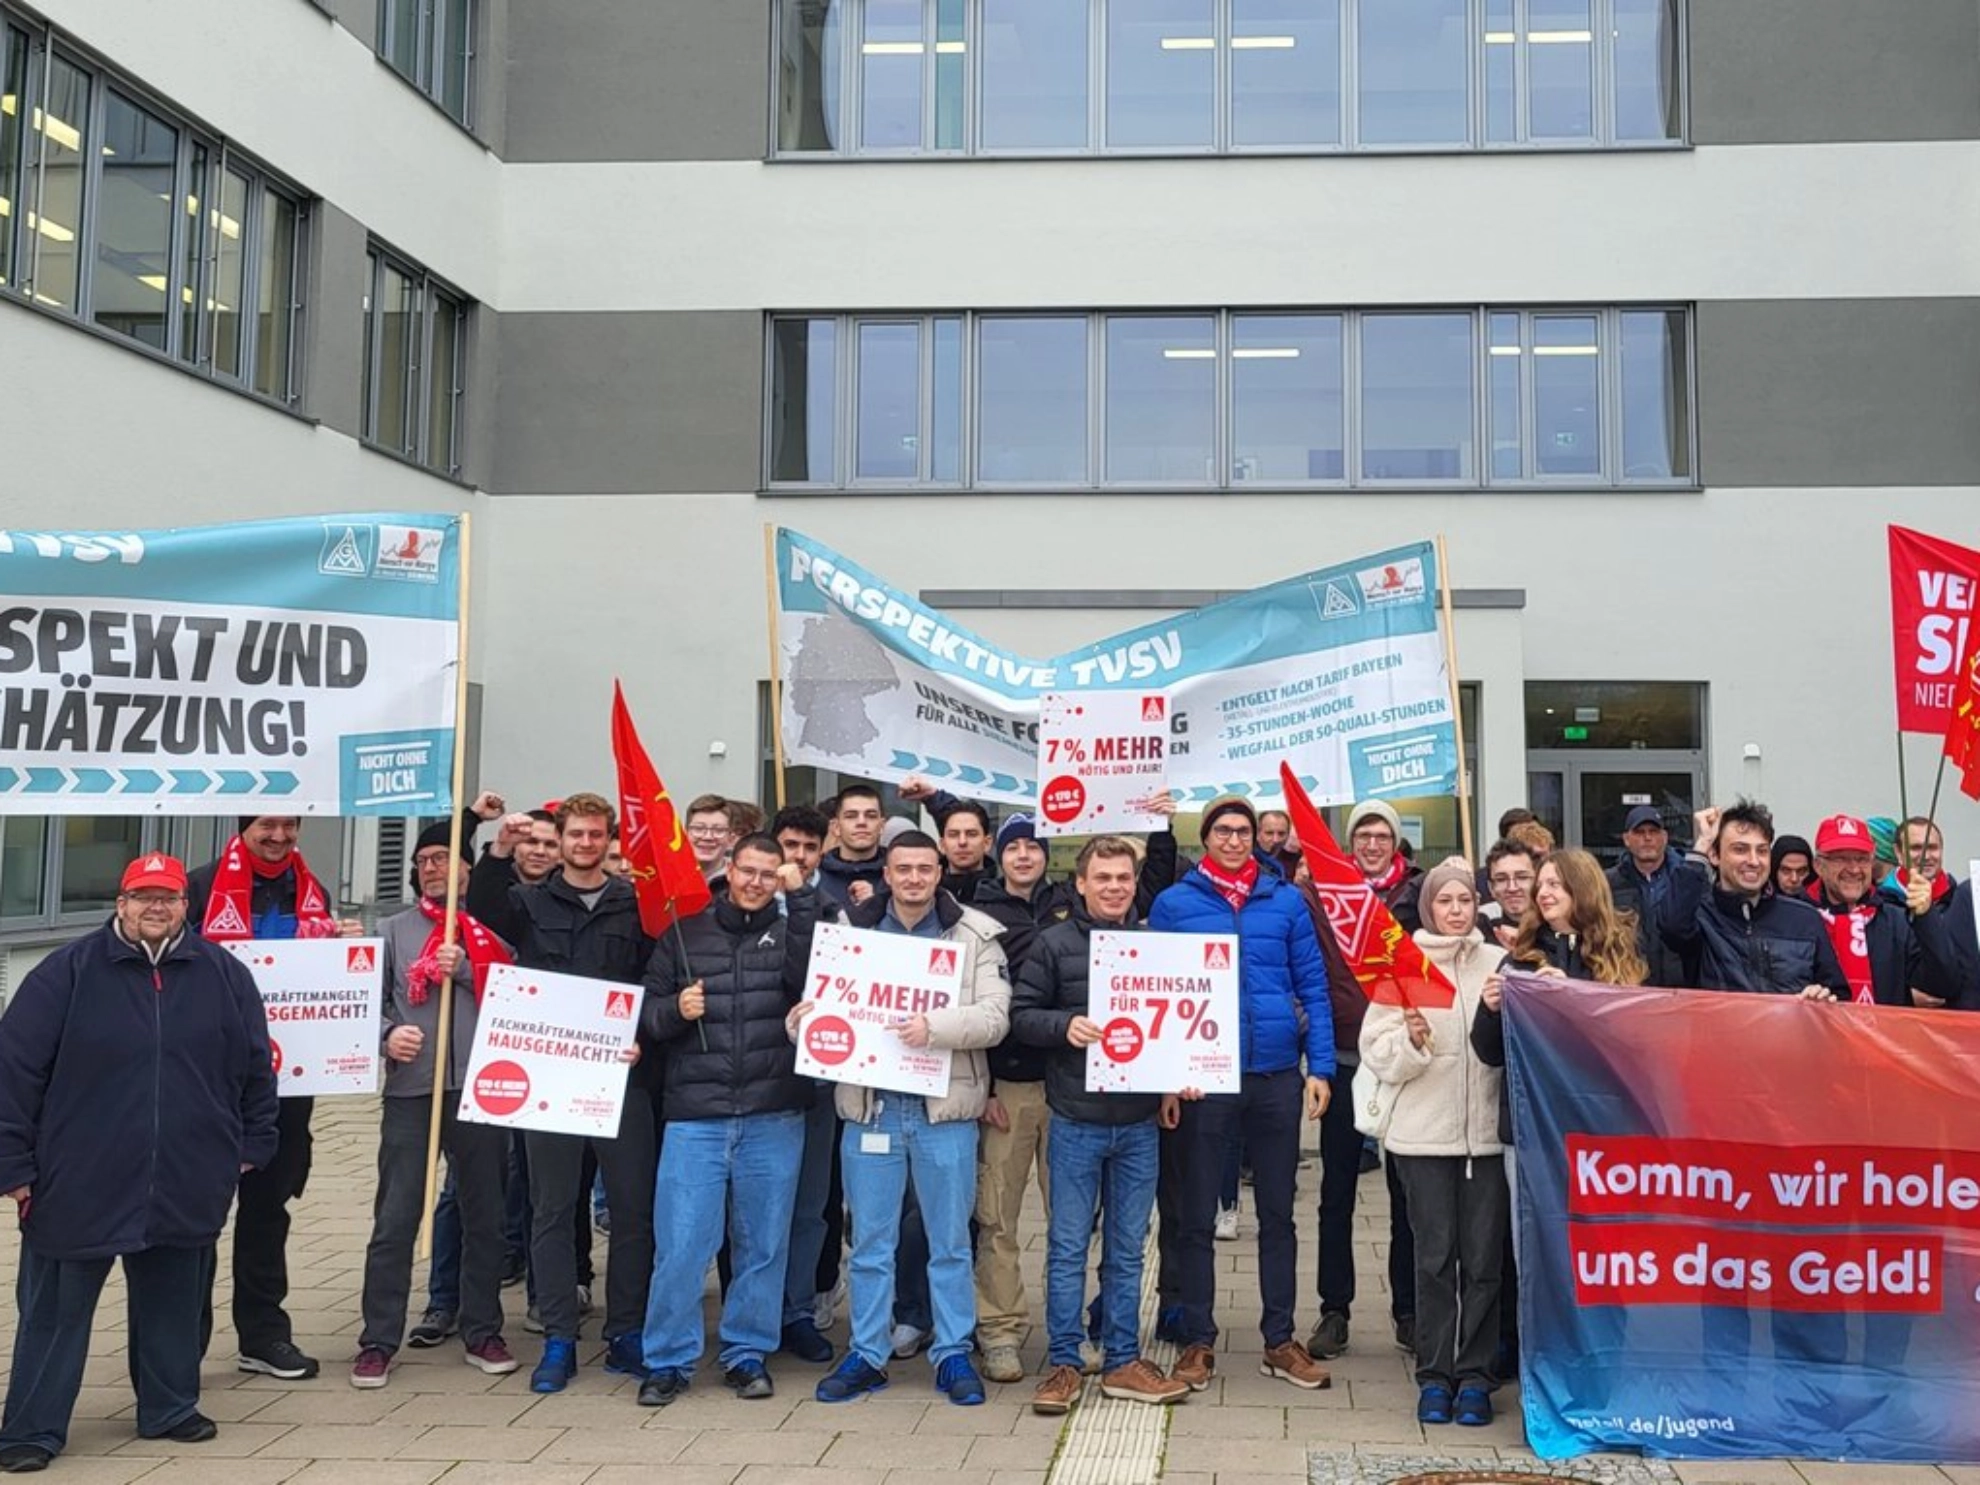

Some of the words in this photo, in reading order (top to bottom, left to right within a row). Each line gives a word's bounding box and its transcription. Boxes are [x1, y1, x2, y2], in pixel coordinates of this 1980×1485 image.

[791, 545, 1057, 687] PERSPEKTIVE
[1071, 630, 1183, 685] TVSV
[236, 618, 369, 689] UND
[1222, 688, 1278, 712] ENTGELT
[1281, 680, 1313, 699] NACH
[1317, 667, 1350, 688] TARIF
[1353, 653, 1403, 678] BAYERN
[0, 672, 308, 758] HÄTZUNG!
[914, 681, 1009, 735] UNSERE
[916, 704, 945, 724] FÜR
[948, 715, 980, 735] ALLE
[1227, 696, 1355, 740] 35-STUNDEN-WOCHE
[1227, 737, 1287, 760] WEGFALL
[1289, 730, 1314, 748] DER
[1316, 698, 1446, 738] 50-QUALI-STUNDEN
[359, 753, 395, 771] NICHT
[396, 749, 429, 767] OHNE
[1094, 736, 1163, 762] MEHR
[1368, 747, 1401, 766] NICHT
[372, 769, 417, 795] DICH
[1078, 763, 1109, 776] NÖTIG
[1113, 764, 1133, 775] UND
[1136, 763, 1162, 775] FAIR!
[1382, 759, 1427, 784] DICH
[868, 982, 951, 1013] MEHR
[1110, 975, 1212, 993] GEMEINSAM
[265, 1004, 368, 1022] SGEMACHT!
[849, 1007, 885, 1024] NÖTIG
[1110, 994, 1139, 1012] FÜR
[491, 1017, 622, 1047] FACHKRÄFTEMANGEL?!
[487, 1031, 619, 1065] HAUSGEMACHT!
[1577, 1149, 1752, 1211] Komm,
[1770, 1160, 1847, 1207] wir
[1863, 1161, 1980, 1209] hole
[1577, 1249, 1659, 1287] uns
[1673, 1243, 1772, 1293] das
[1788, 1249, 1931, 1295] Geld!
